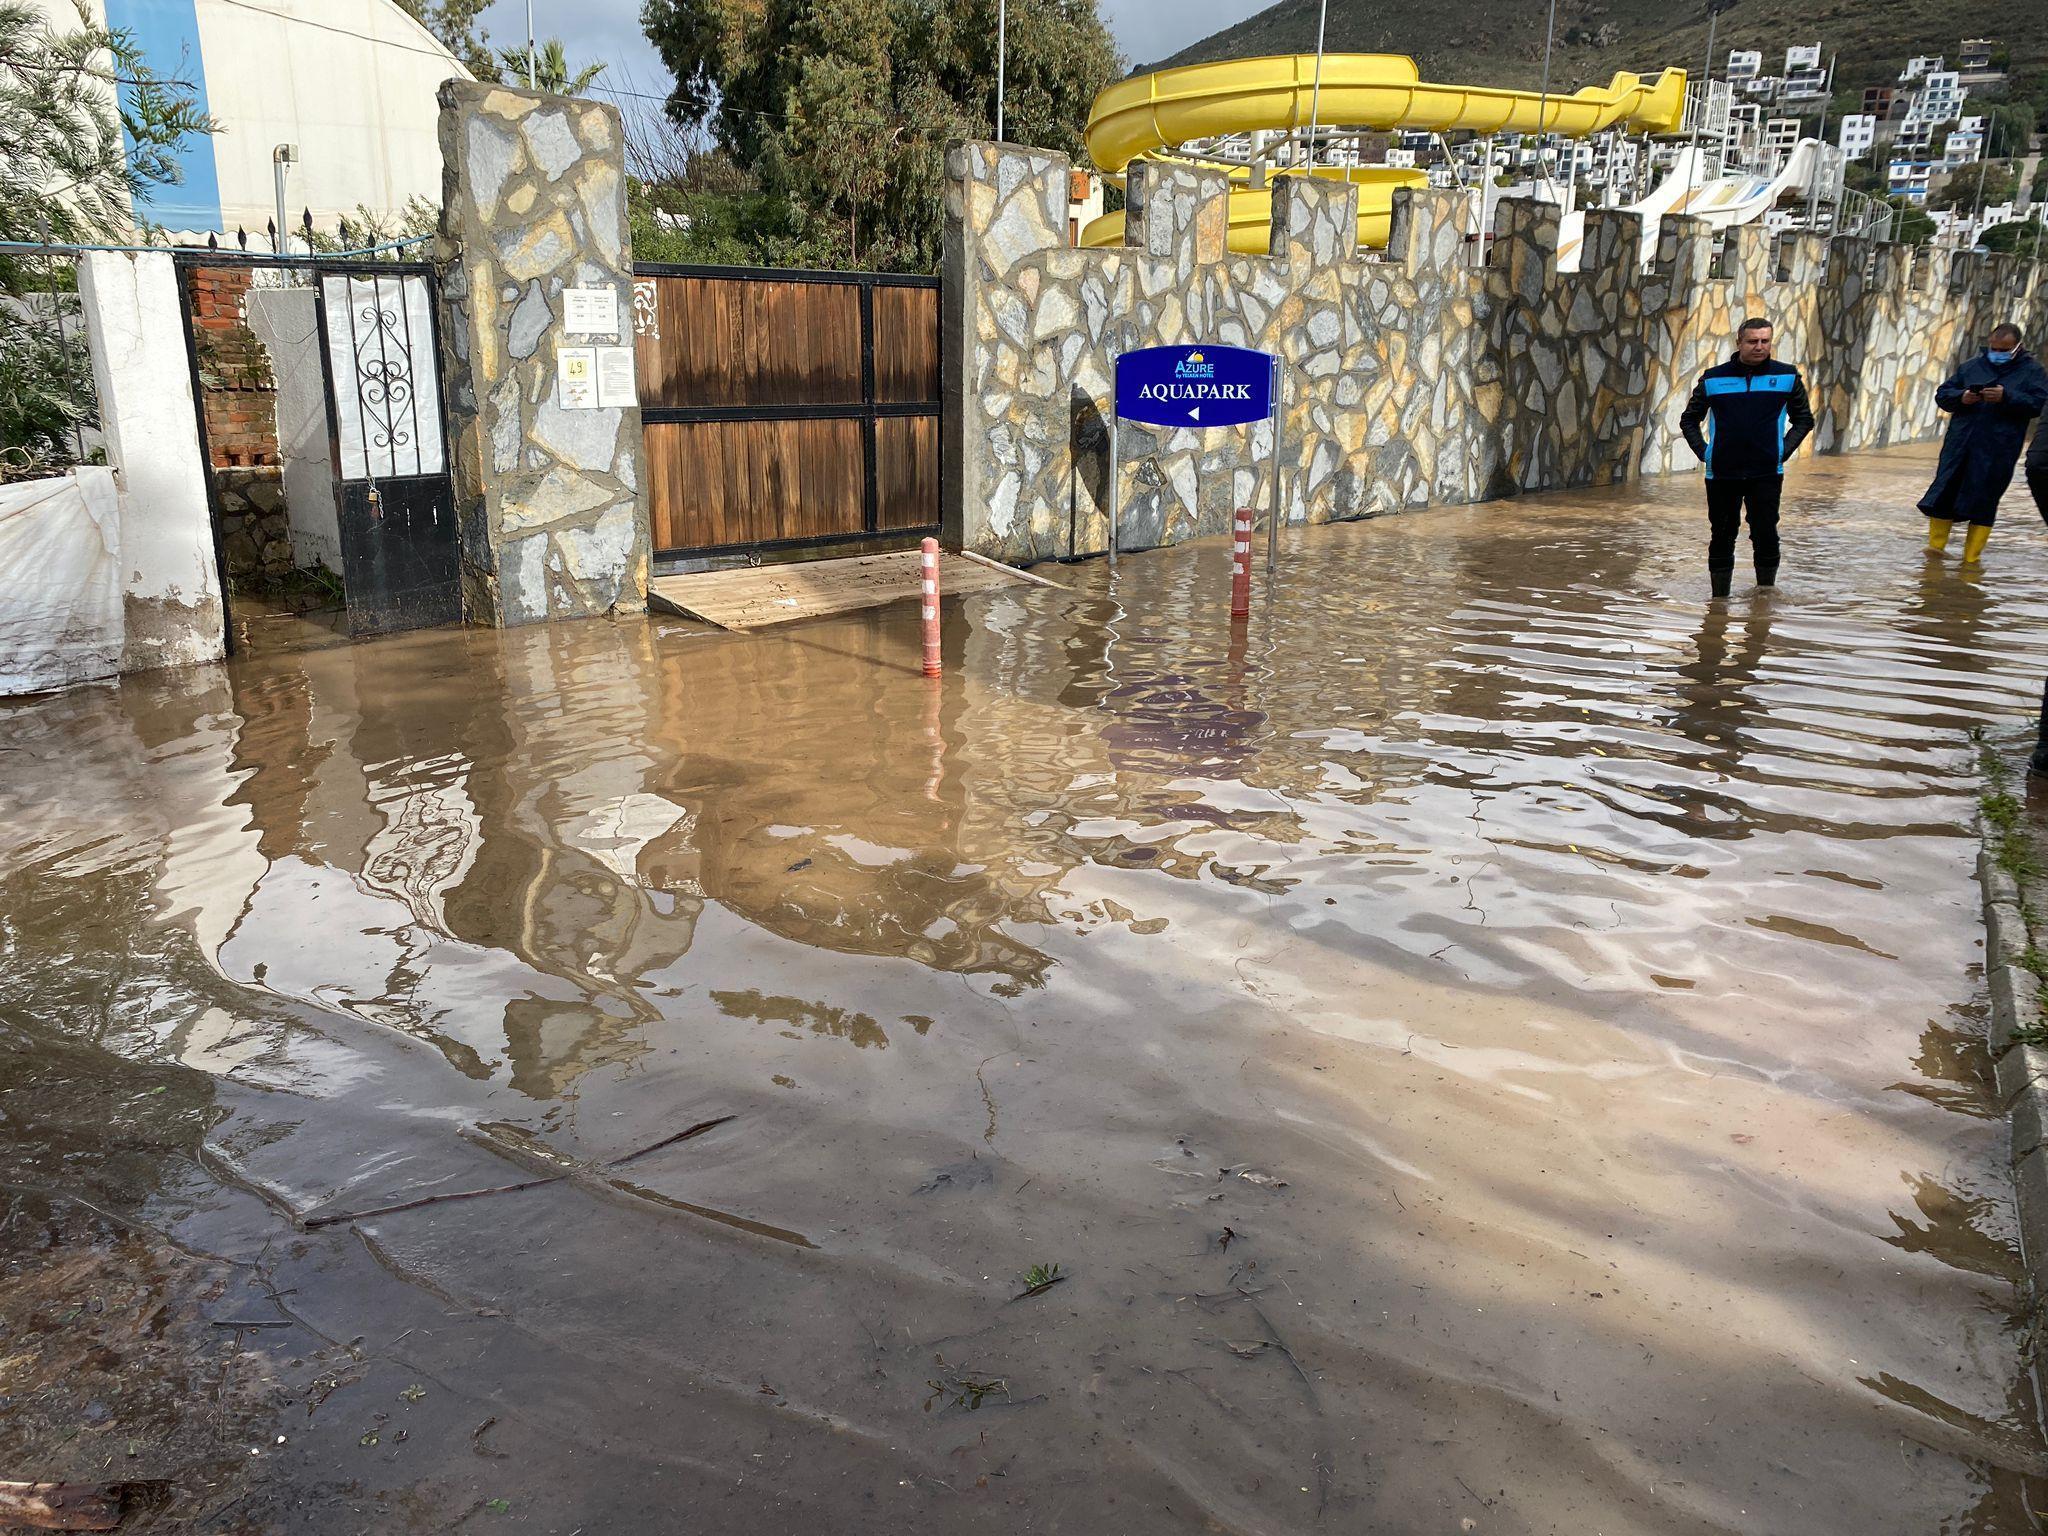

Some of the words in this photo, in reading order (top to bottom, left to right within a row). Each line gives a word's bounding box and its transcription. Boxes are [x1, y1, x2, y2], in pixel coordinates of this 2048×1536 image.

[569, 361, 583, 376] 49
[1175, 360, 1214, 373] AZURE
[1138, 383, 1251, 402] AQUAPARK
